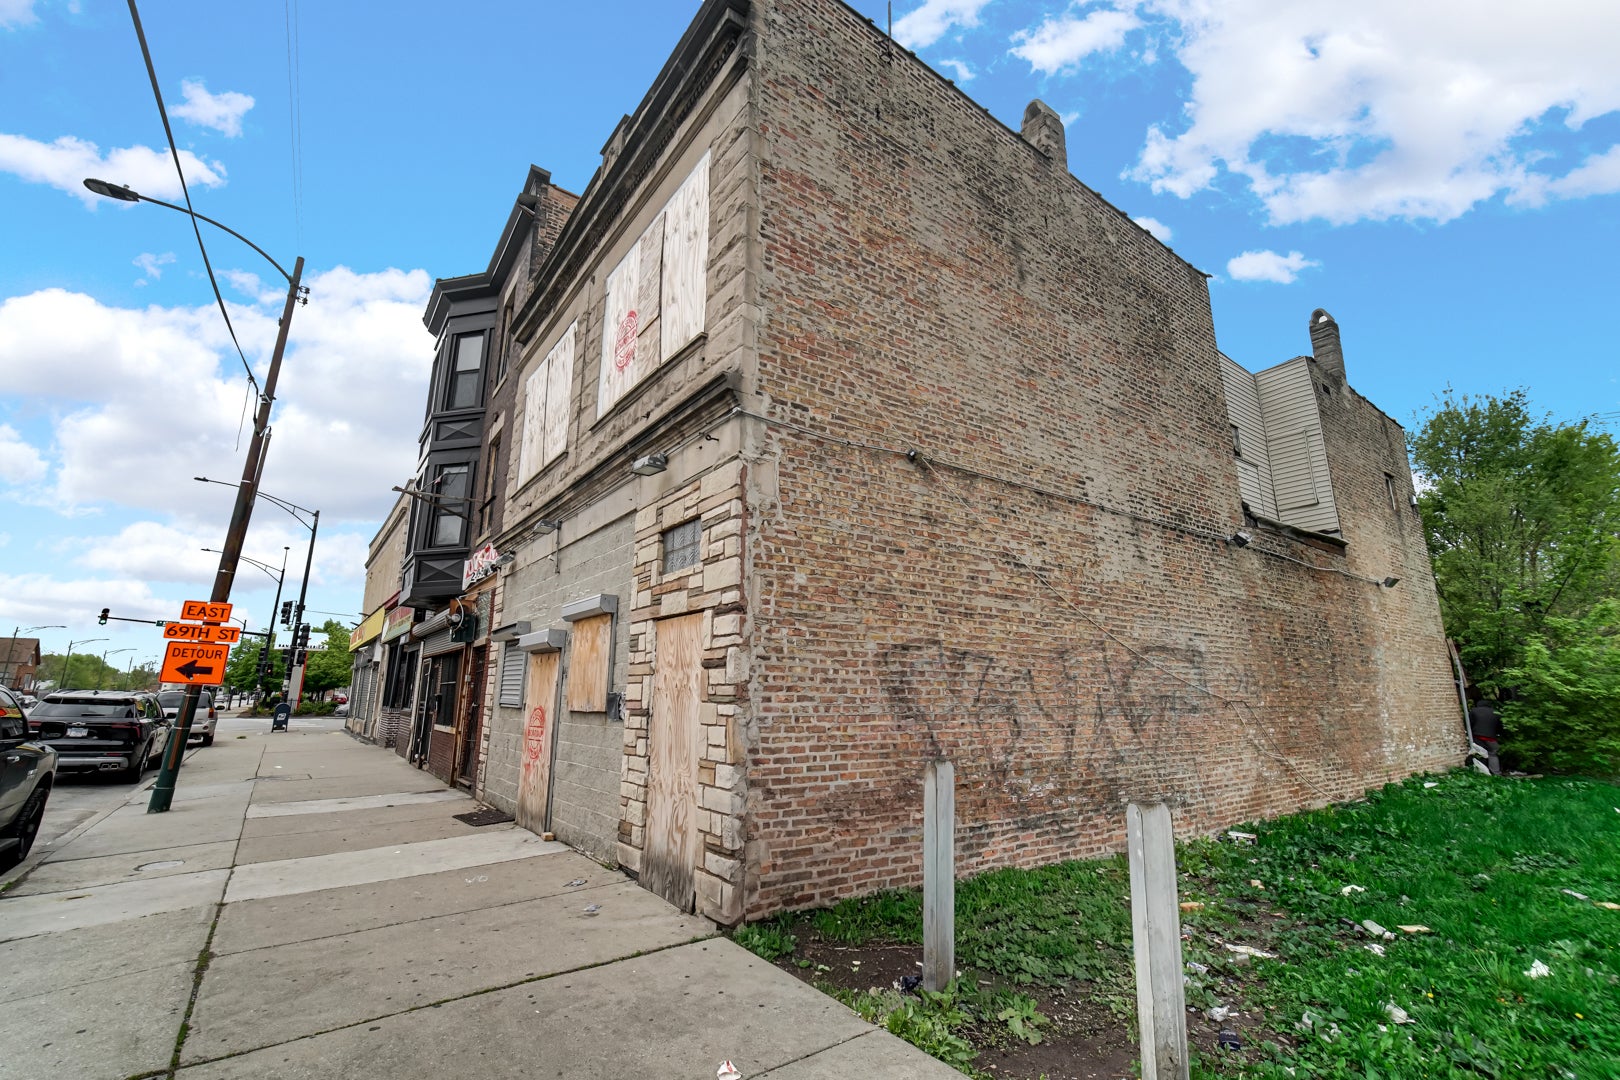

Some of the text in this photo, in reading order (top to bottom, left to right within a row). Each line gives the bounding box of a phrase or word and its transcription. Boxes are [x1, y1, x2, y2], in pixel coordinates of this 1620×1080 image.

[186, 605, 228, 618] EAST
[166, 625, 239, 640] 69TH ST
[171, 647, 223, 660] DETOUR
